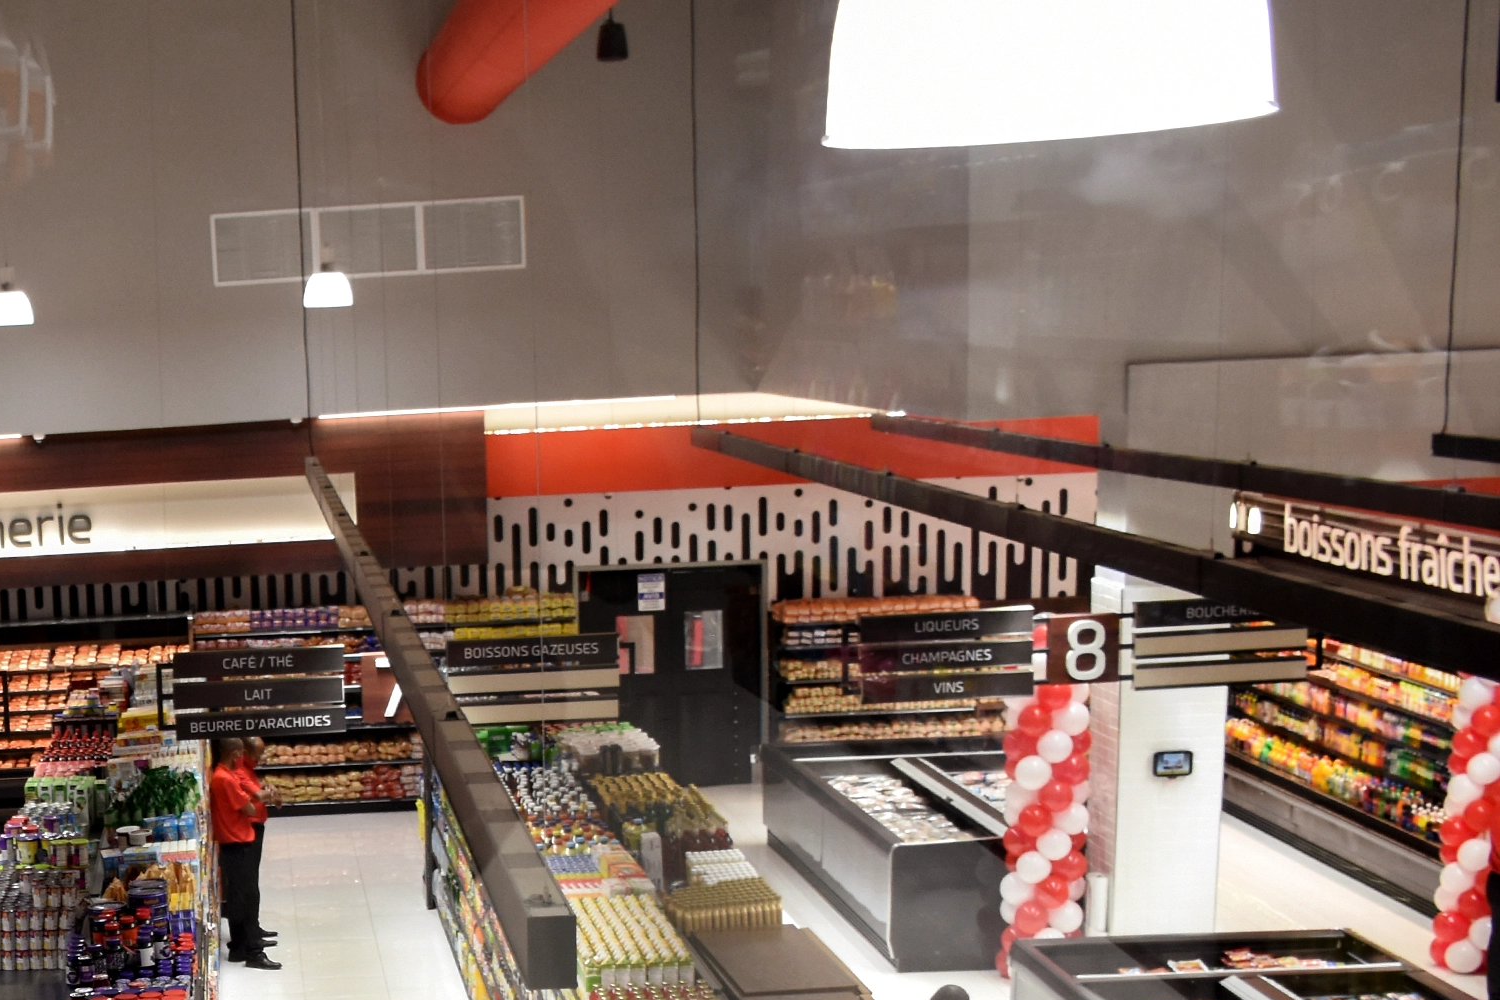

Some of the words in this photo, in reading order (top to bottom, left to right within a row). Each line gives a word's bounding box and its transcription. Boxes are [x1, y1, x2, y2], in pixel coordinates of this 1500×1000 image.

[1284, 503, 1394, 576] boissons
[914, 618, 980, 633] LIQUEURS
[463, 645, 529, 660] BOISSONS
[531, 642, 600, 657] GAZEUSES
[902, 649, 993, 664] CHAMPAGNES
[1065, 619, 1106, 681] 8
[222, 654, 256, 670] CAFÉ
[267, 653, 294, 667] THÉ
[244, 688, 273, 701] LAIT
[933, 681, 964, 694] VINS
[190, 719, 242, 733] BEURRE
[245, 715, 332, 730] D'ARACHIDES
